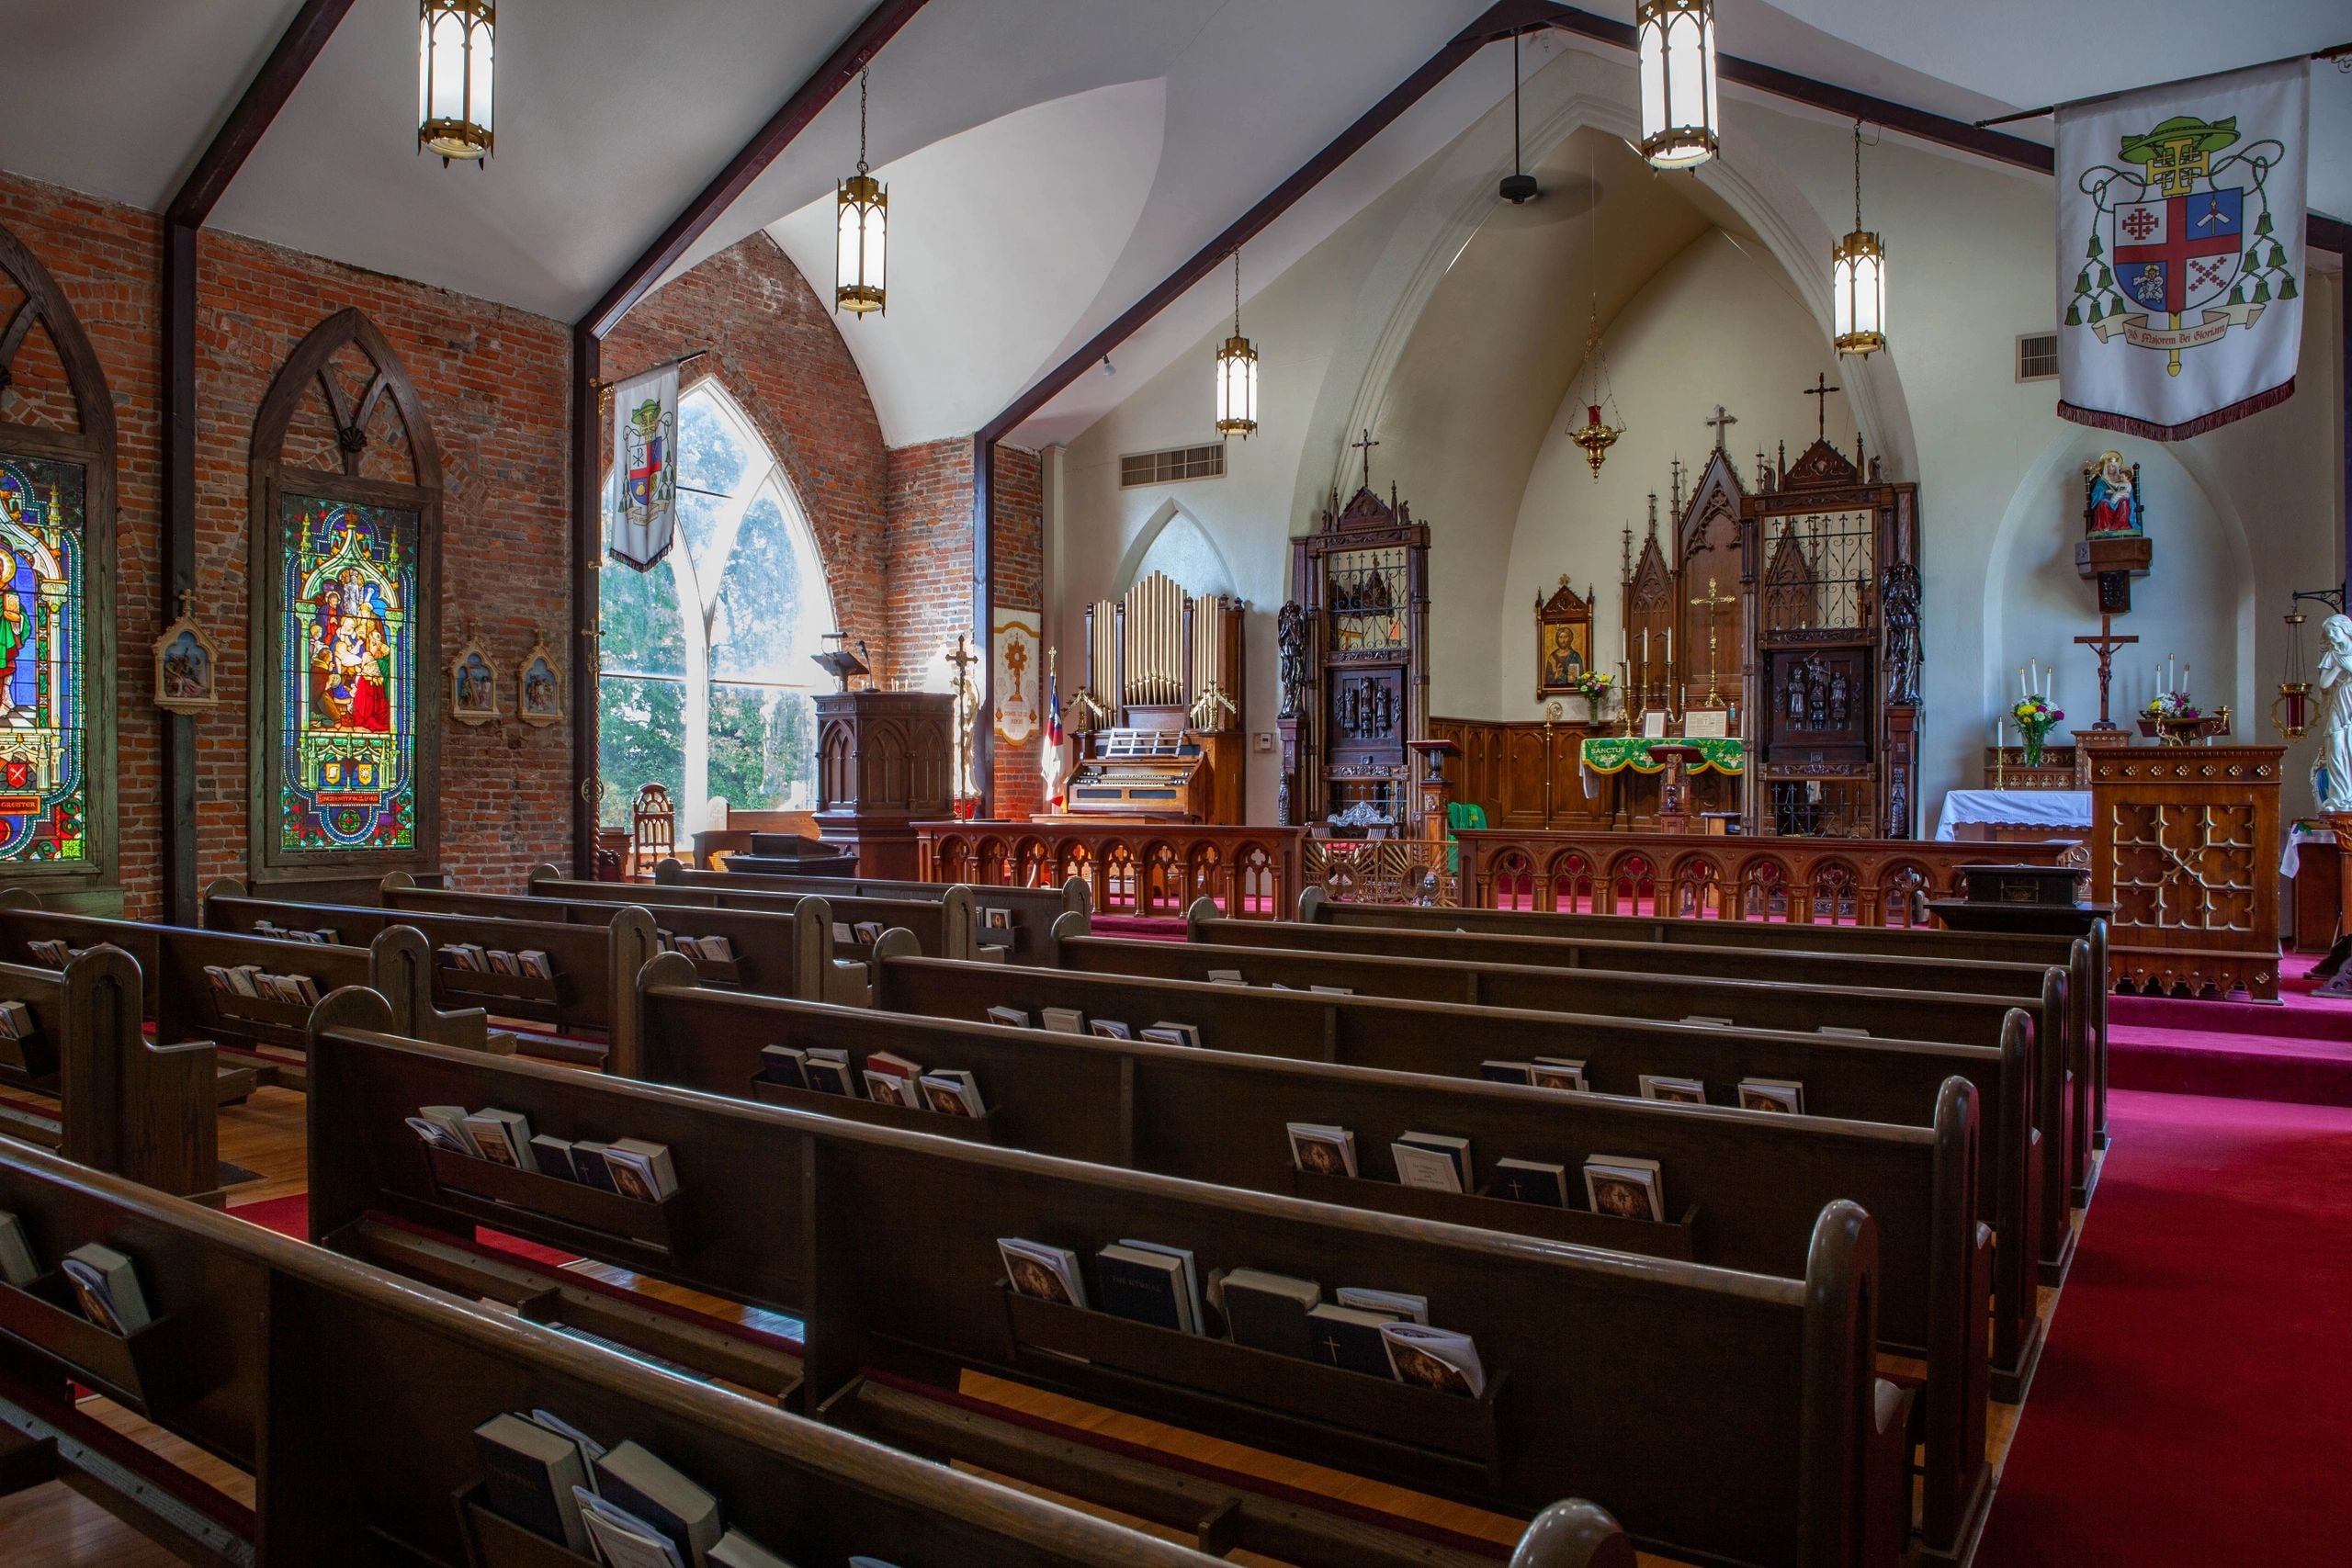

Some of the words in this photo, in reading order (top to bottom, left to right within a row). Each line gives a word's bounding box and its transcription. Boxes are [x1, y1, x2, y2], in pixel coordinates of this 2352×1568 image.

[2127, 329, 2138, 340] Ad
[2141, 332, 2177, 345] Majorem
[2178, 333, 2191, 344] Dei
[2193, 324, 2225, 341] Gloriam
